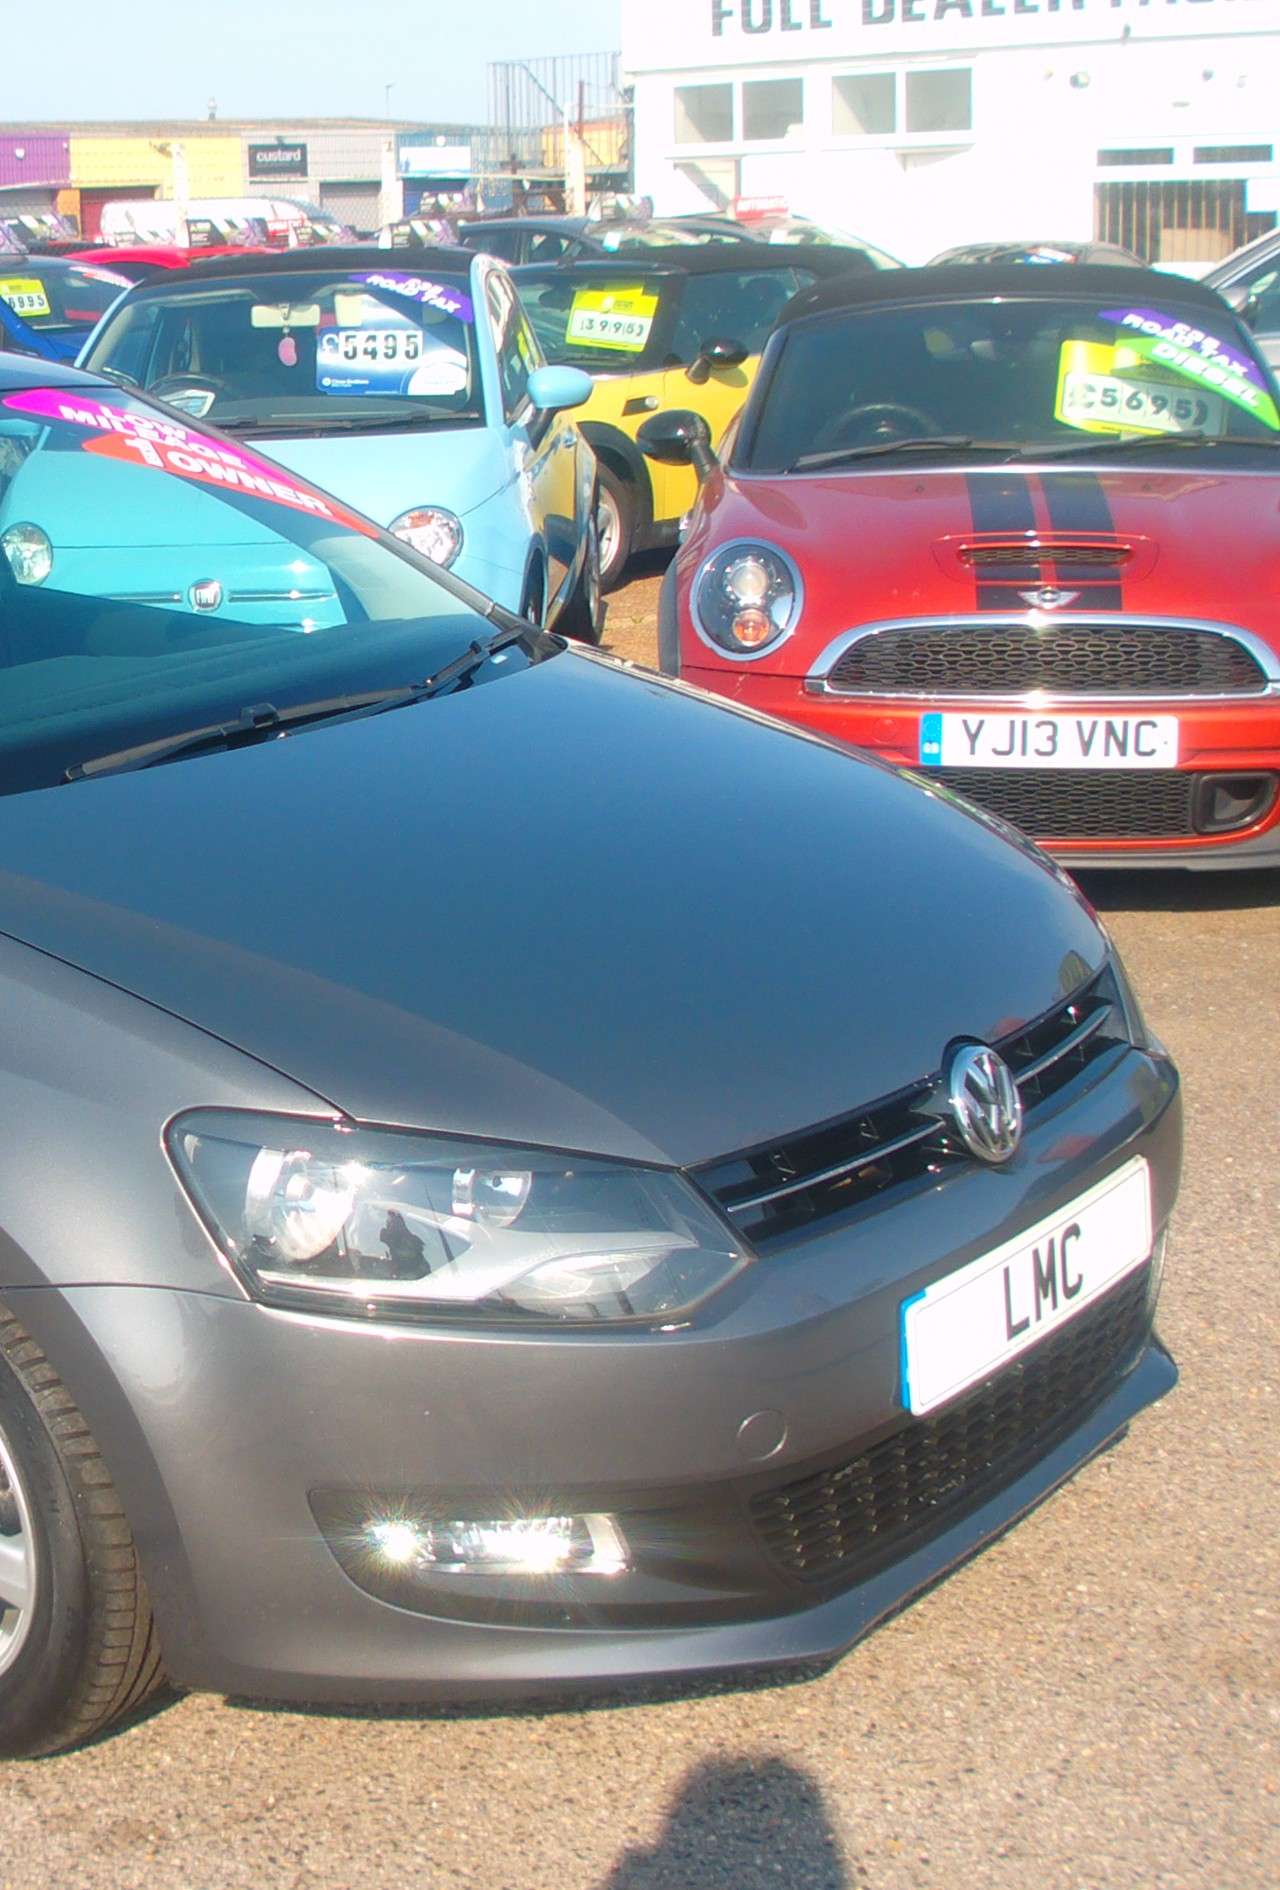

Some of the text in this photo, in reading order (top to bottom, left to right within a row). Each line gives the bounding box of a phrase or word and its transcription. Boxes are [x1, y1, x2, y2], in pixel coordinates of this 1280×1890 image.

[862, 0, 1084, 25] DEA
[256, 147, 302, 162] custard
[59, 404, 248, 470] MILEAGE
[99, 404, 188, 441] LOW
[125, 437, 334, 517] 1 OWNER
[961, 719, 1158, 757] YJ13 VNC
[1003, 1222, 1083, 1342] LMC
